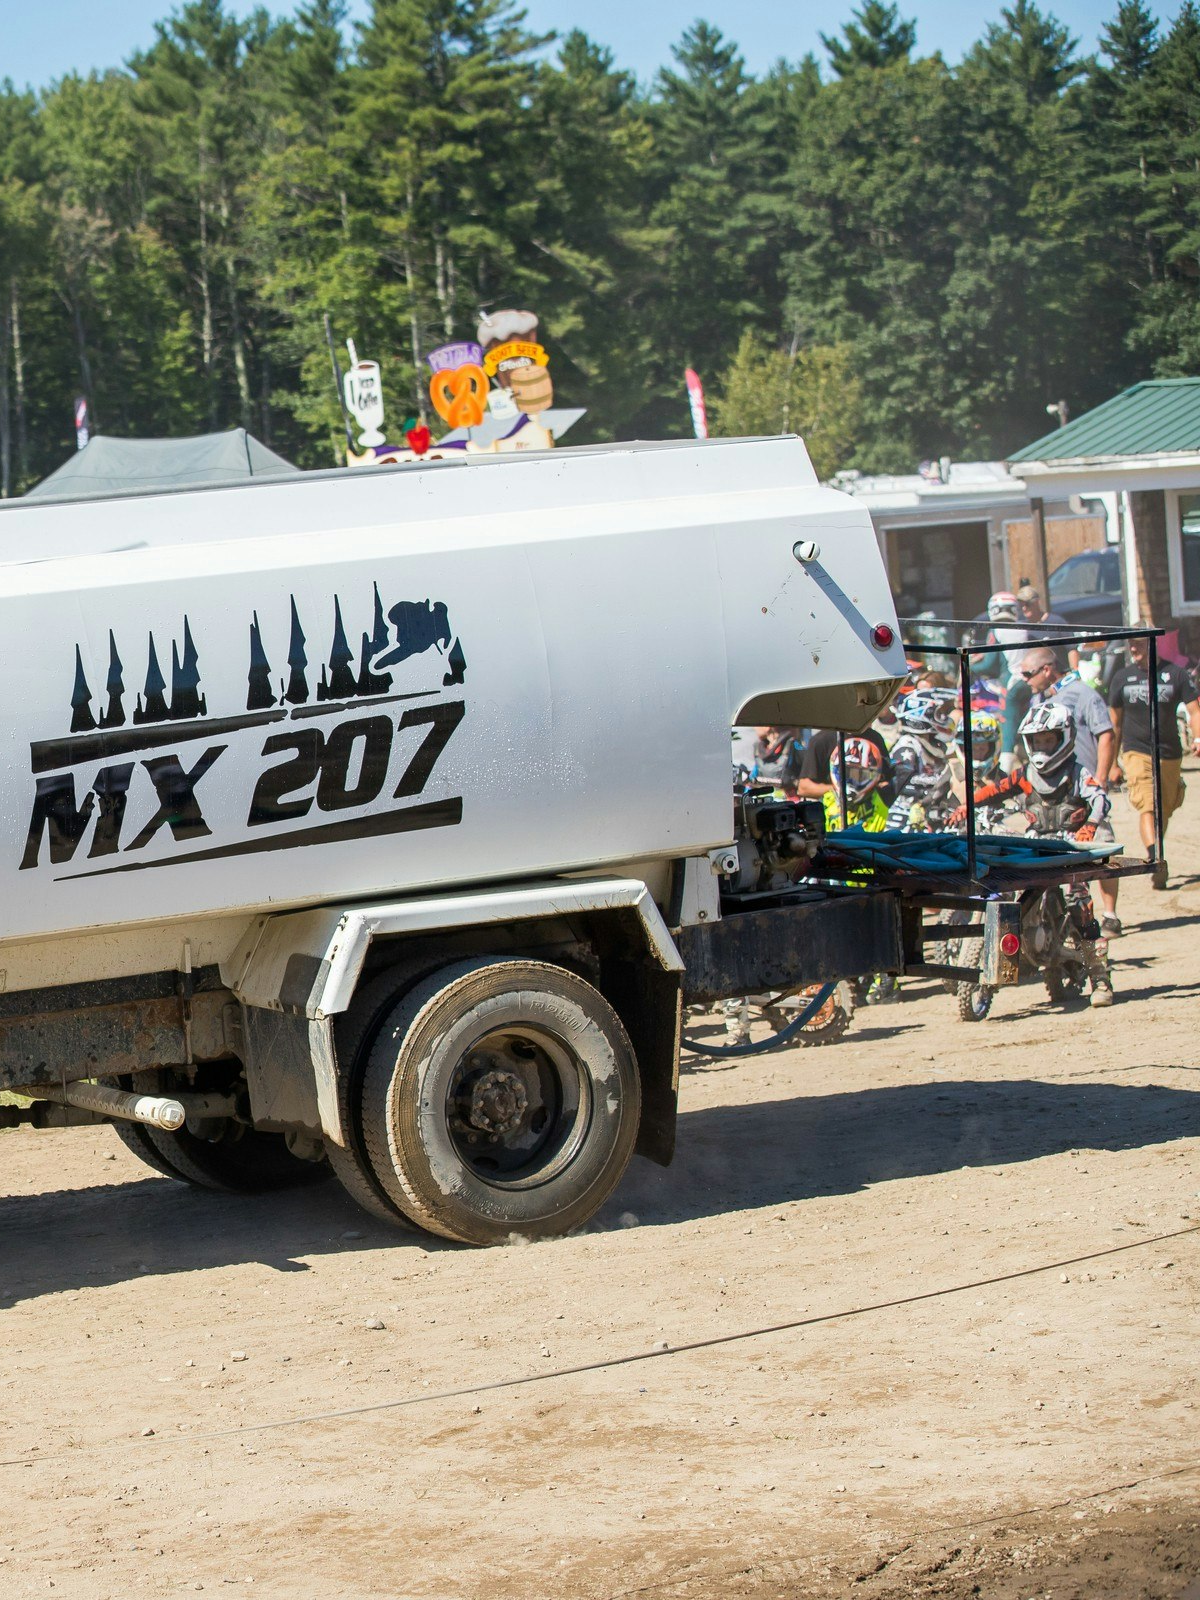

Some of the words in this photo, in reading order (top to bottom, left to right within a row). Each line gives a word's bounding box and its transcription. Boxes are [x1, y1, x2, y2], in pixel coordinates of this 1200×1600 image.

[489, 345, 512, 361] ROOT
[516, 344, 538, 356] BEER
[18, 745, 228, 870] MX
[247, 700, 465, 827] 207
